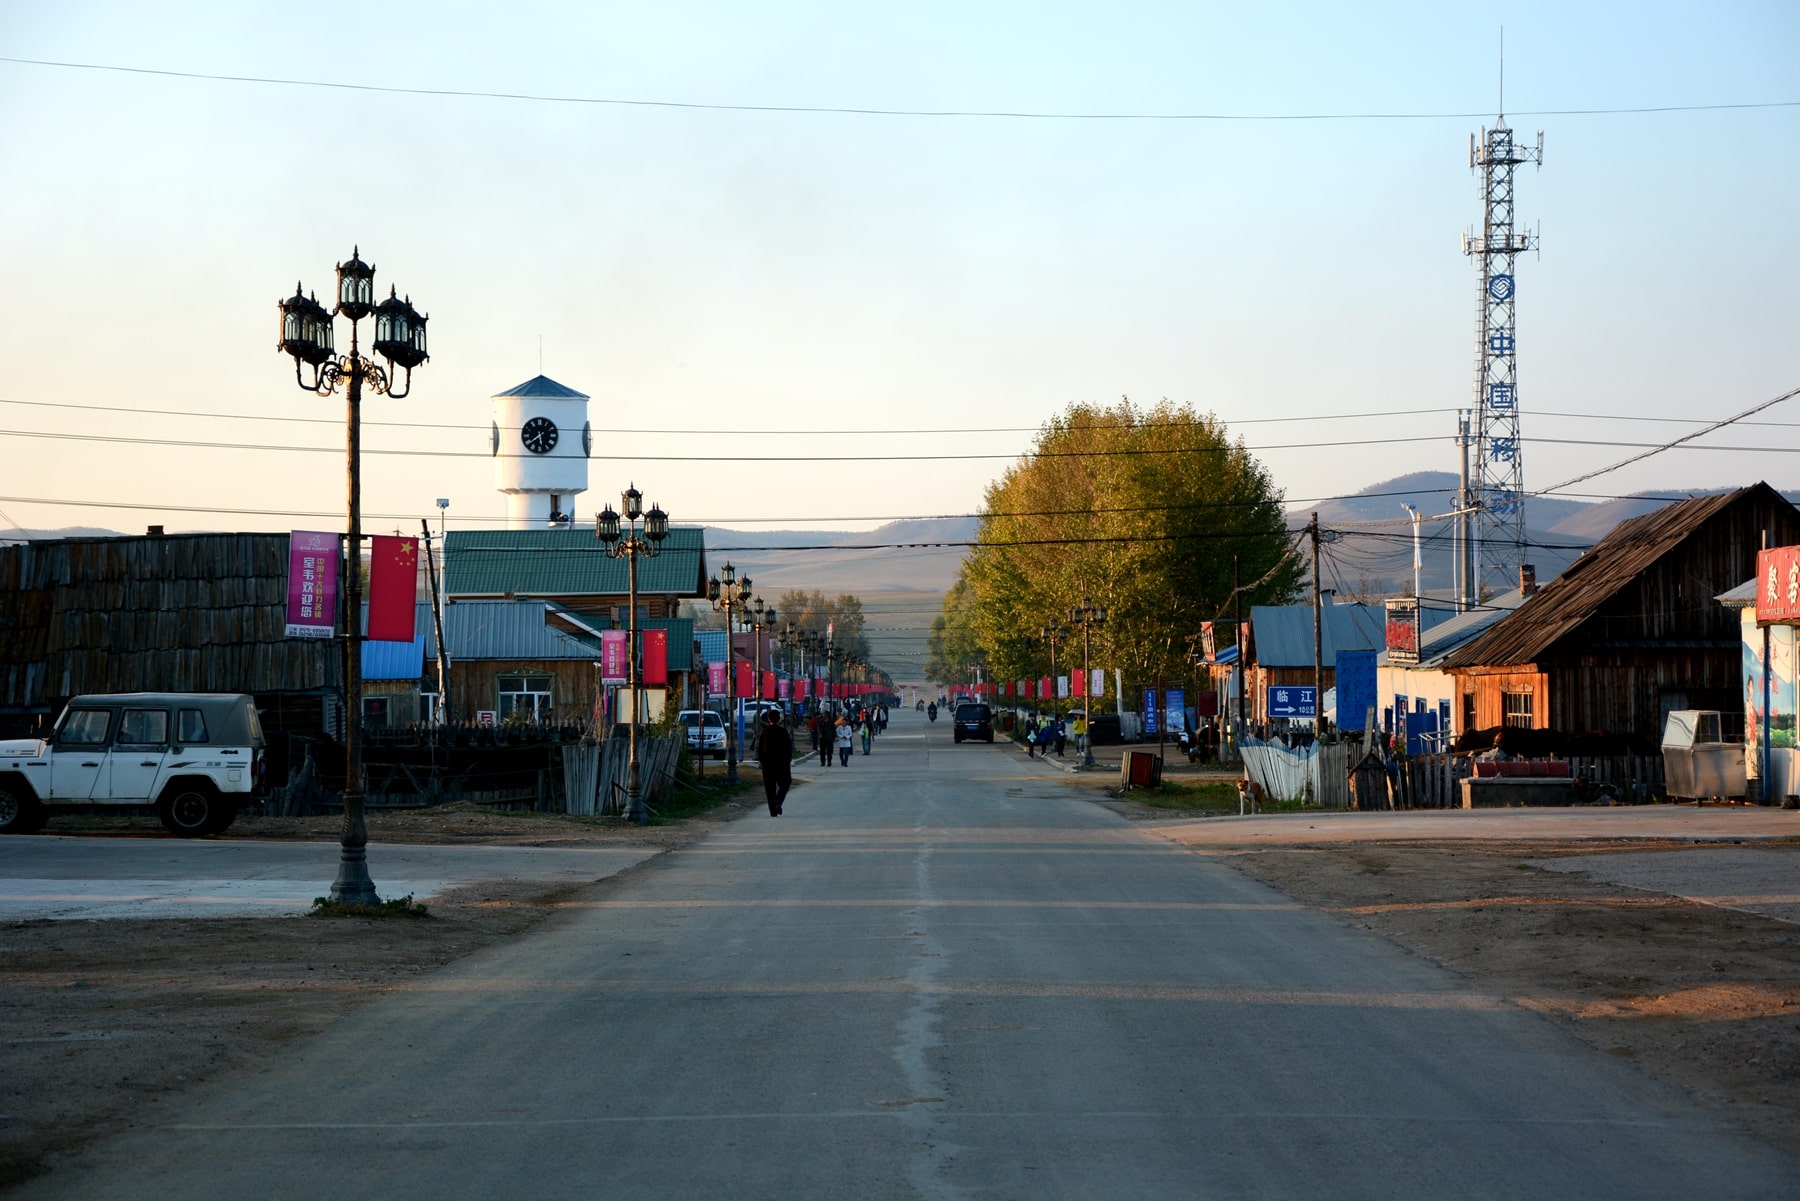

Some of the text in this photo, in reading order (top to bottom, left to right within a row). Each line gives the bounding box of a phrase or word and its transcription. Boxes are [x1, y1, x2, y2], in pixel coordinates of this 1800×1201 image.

[1489, 331, 1518, 515] 中国移动
[300, 557, 315, 618] 室韦欢迎您
[1276, 690, 1313, 703] 临江
